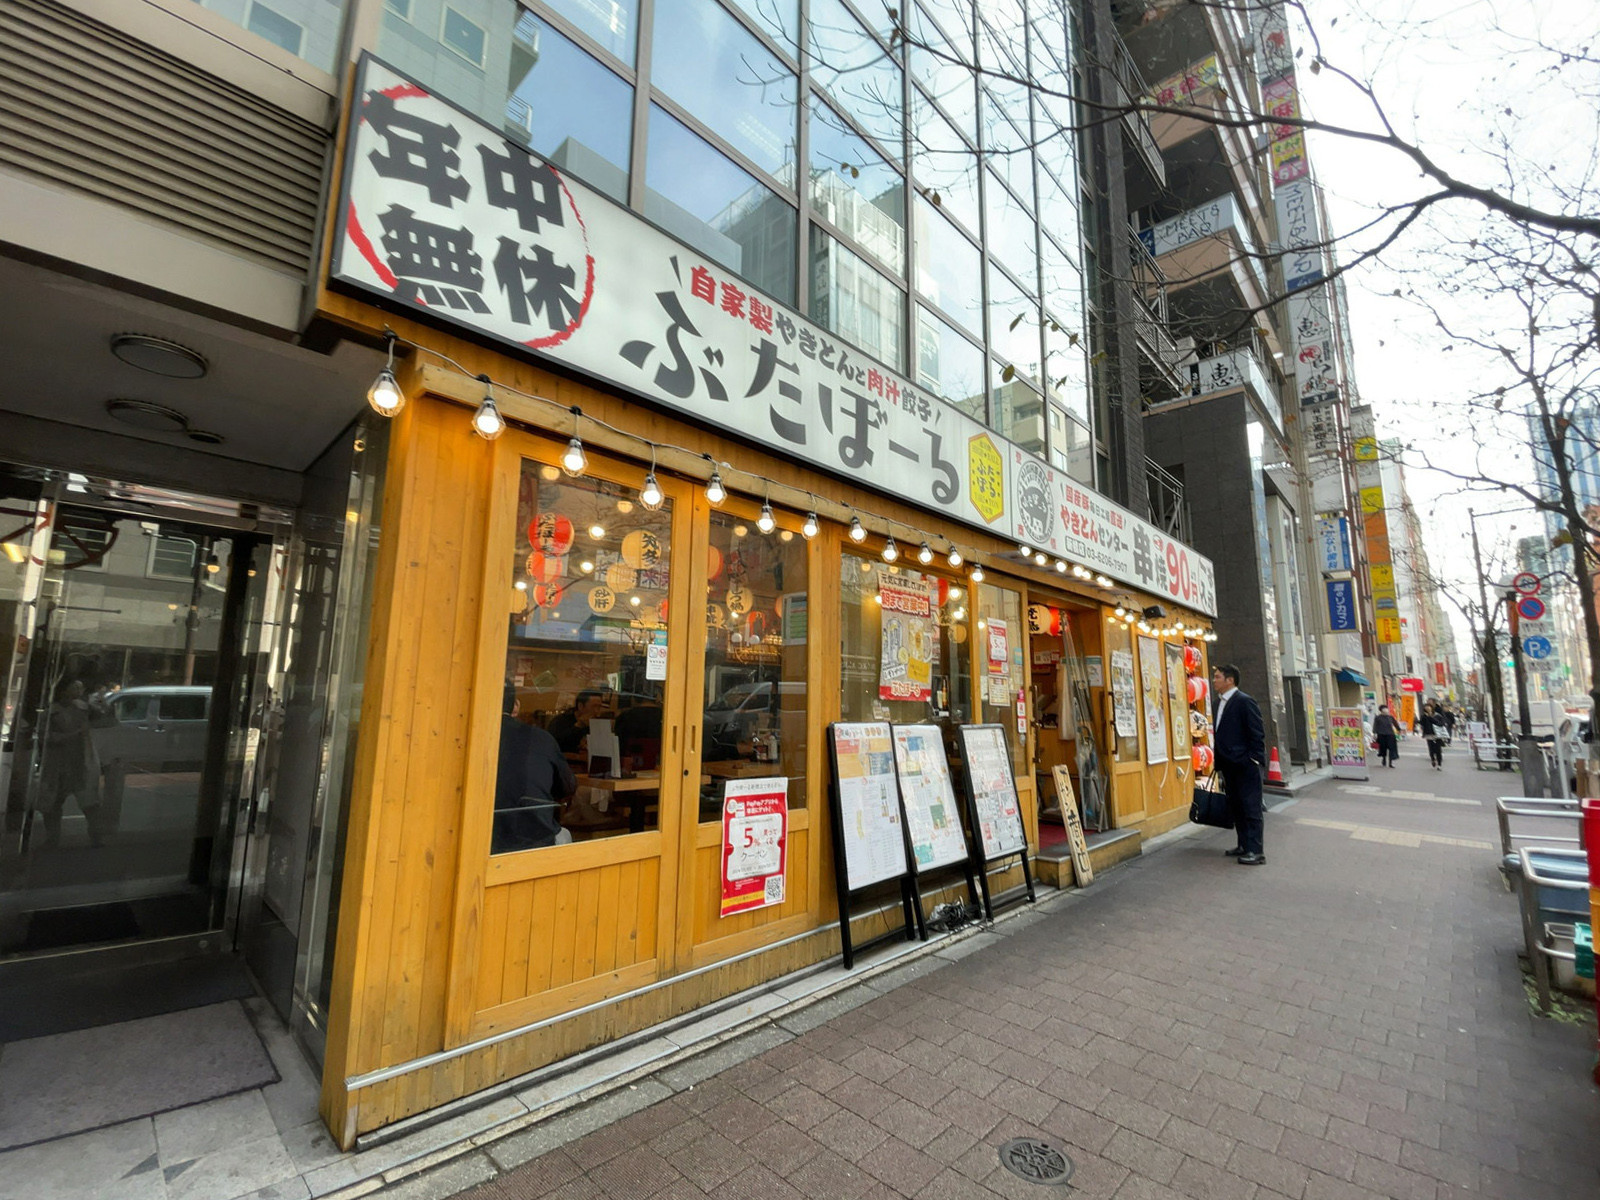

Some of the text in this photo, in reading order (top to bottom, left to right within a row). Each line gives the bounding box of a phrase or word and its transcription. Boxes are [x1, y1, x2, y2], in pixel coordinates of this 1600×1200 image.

[360, 89, 565, 235] 年中
[376, 202, 582, 332] 無休
[1060, 503, 1129, 554] やきとんセンター
[1528, 641, 1541, 657] P
